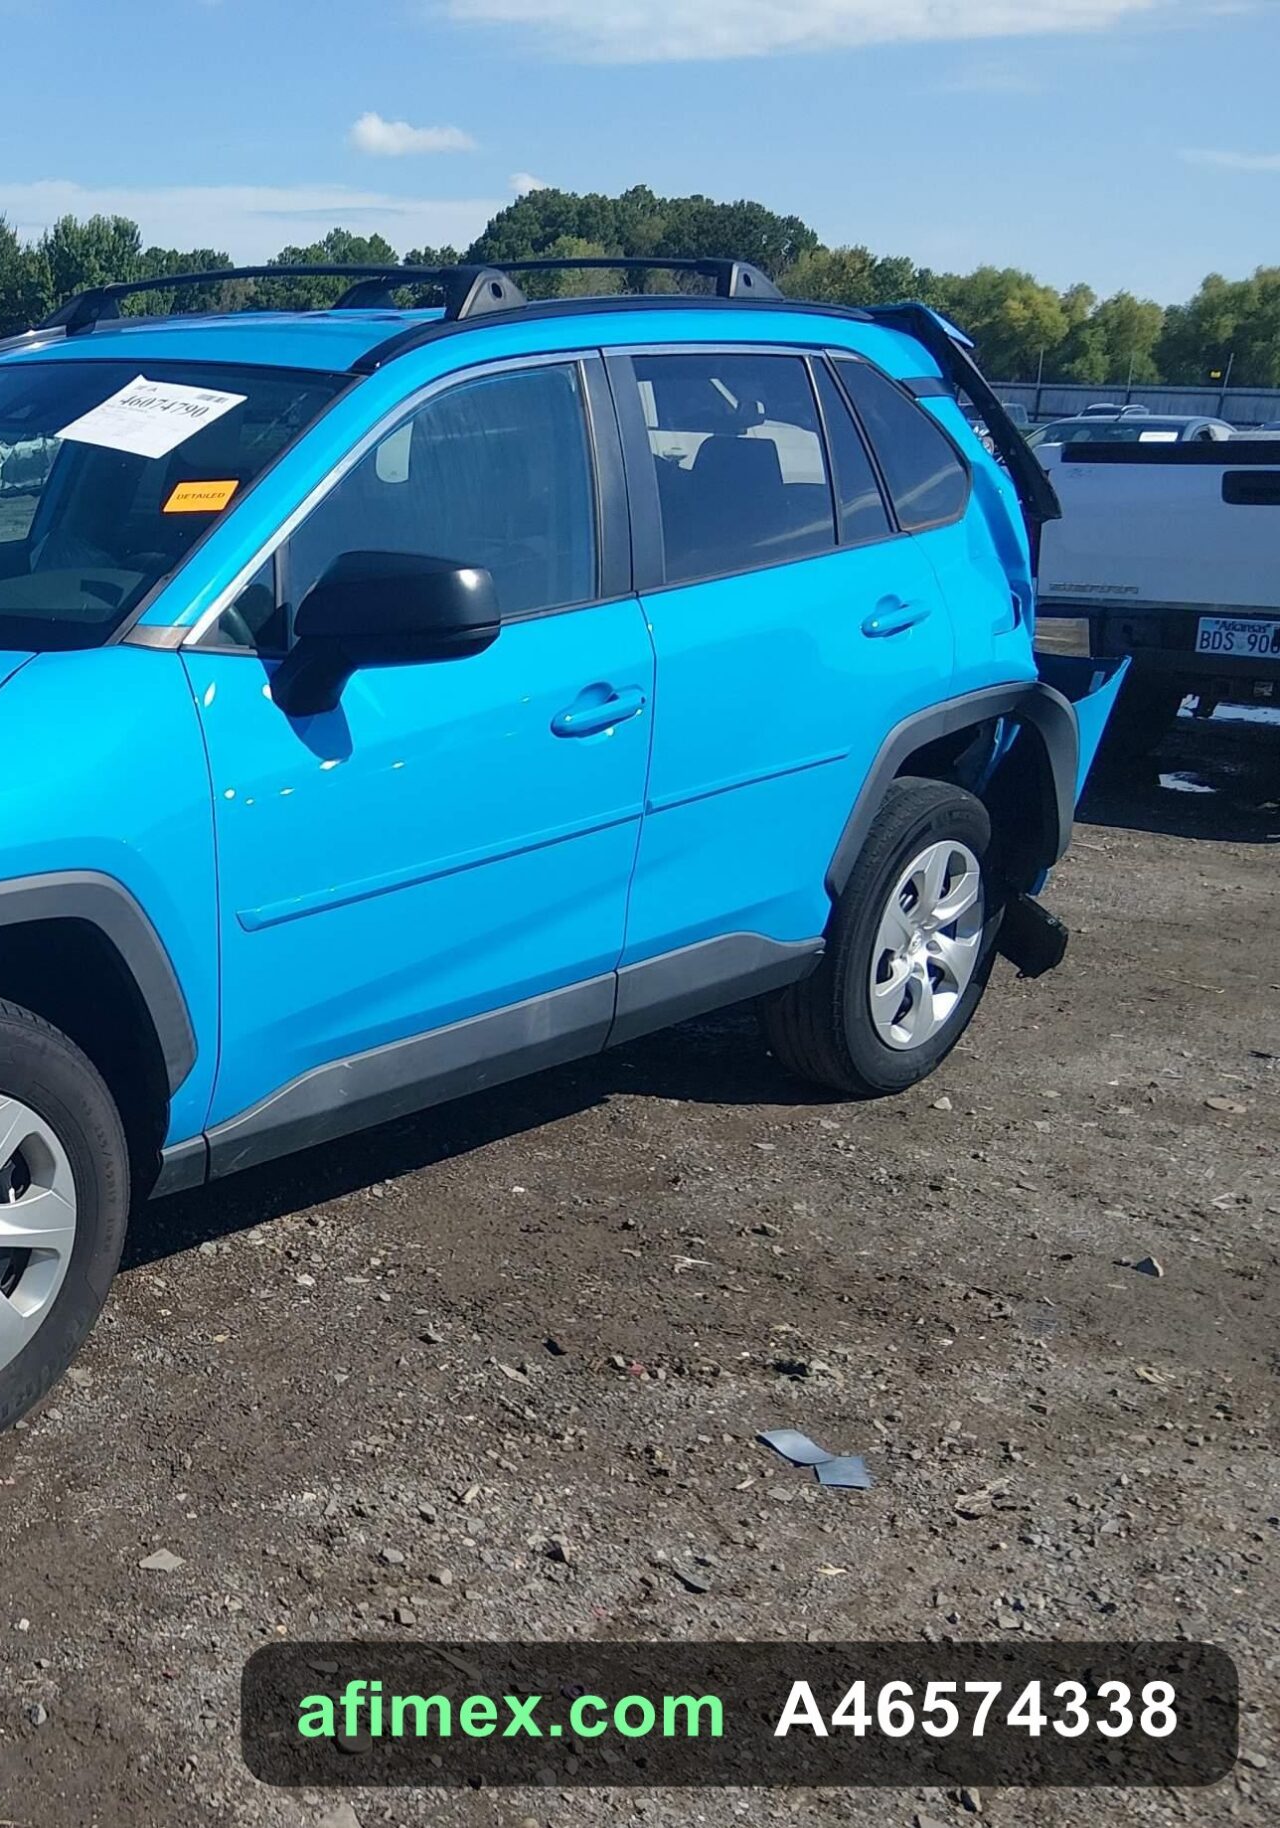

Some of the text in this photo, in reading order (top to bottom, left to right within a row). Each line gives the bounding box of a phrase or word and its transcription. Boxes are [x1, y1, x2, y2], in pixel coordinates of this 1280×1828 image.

[120, 394, 210, 418] 46074790
[176, 491, 226, 500] DETAILED
[1200, 630, 1234, 651] BDS
